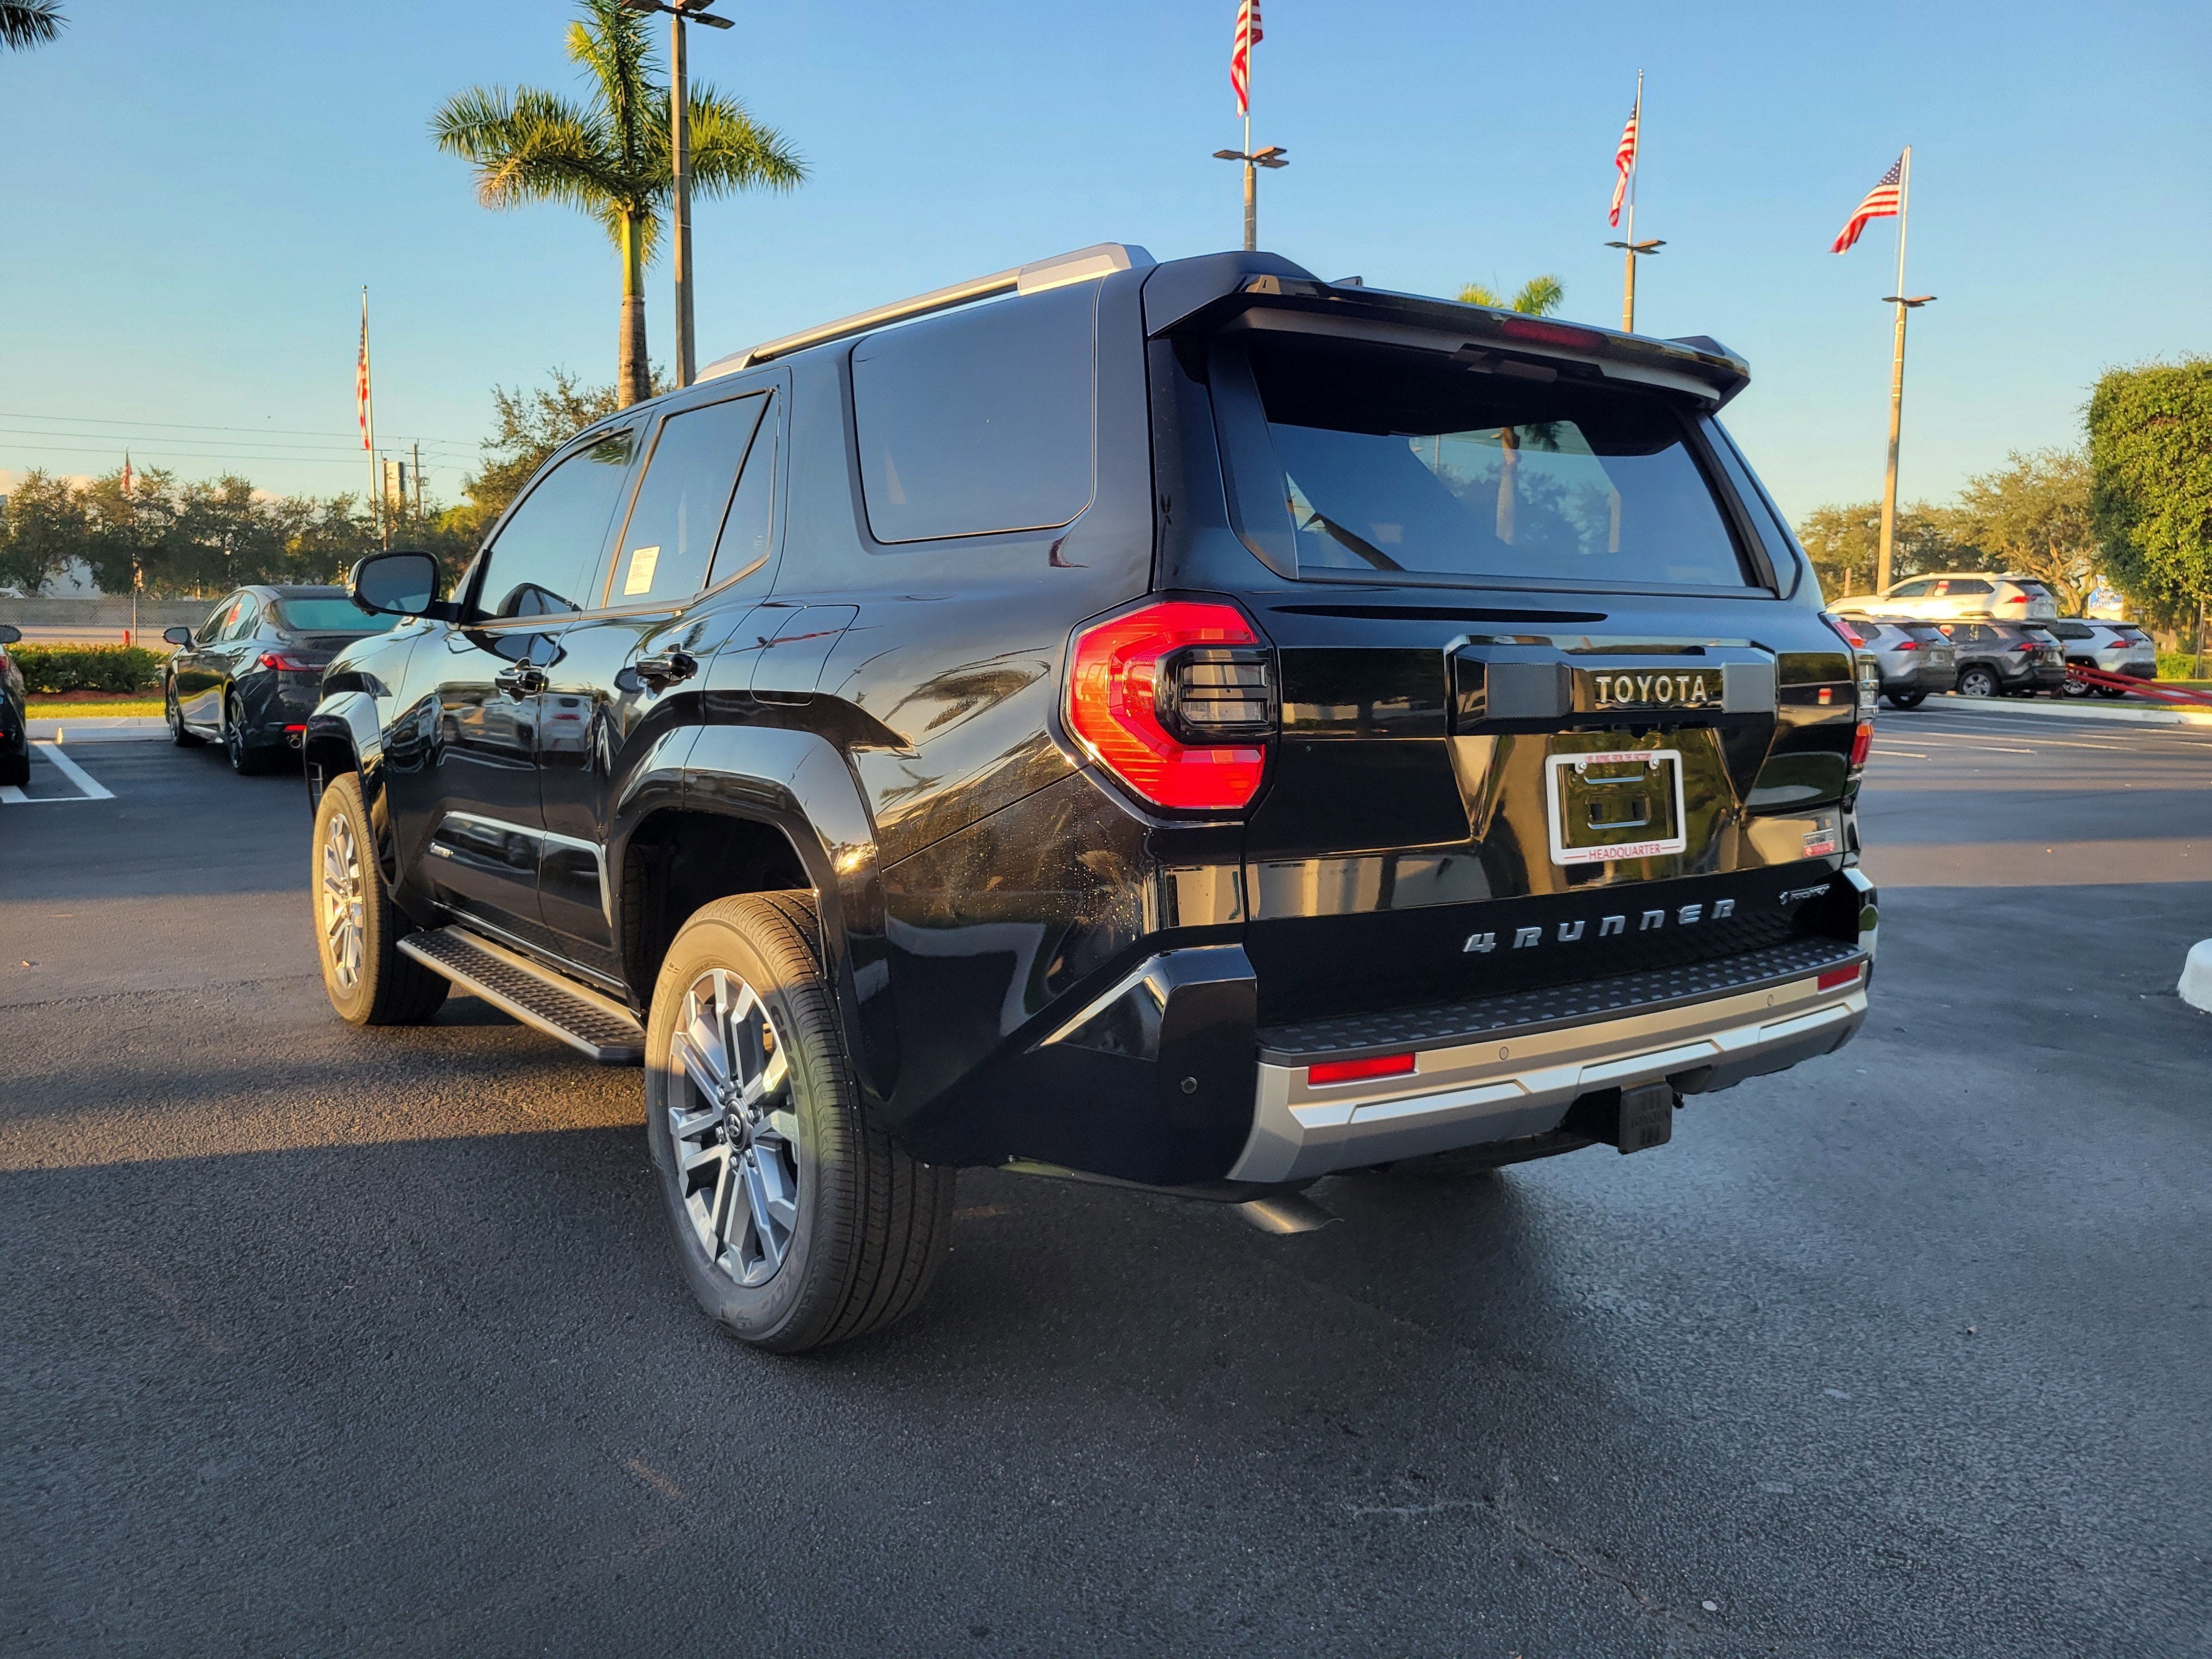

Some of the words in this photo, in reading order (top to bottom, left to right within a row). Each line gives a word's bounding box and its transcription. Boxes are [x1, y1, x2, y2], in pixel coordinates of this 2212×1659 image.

[1595, 675, 1707, 703] TOYOTA
[1589, 844, 1661, 860] HEADQUARTER
[1463, 899, 1735, 953] 4RUNNER
